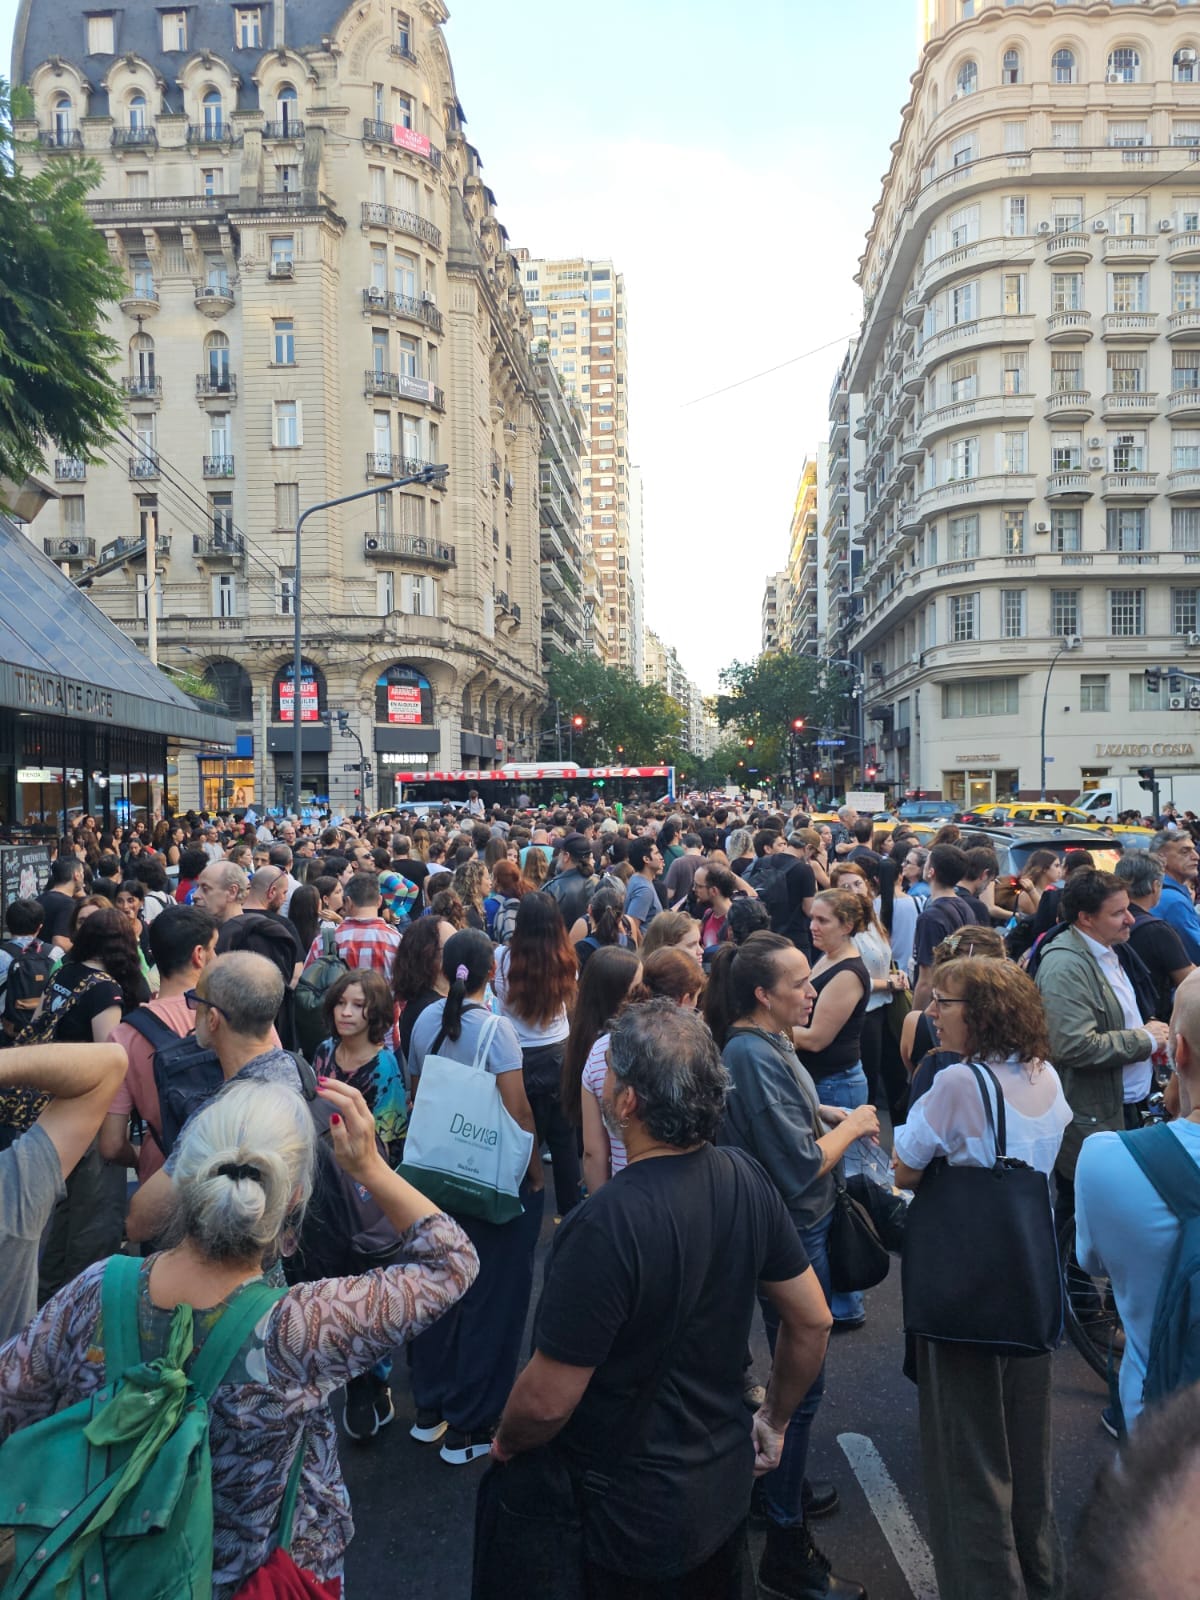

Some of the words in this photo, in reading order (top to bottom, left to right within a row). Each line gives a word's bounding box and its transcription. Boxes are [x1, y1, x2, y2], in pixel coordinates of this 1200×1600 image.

[15, 672, 65, 708] TIENDA
[67, 684, 83, 712] DE
[1151, 743, 1195, 758] COSTA
[382, 753, 429, 763] SAMSUNG
[413, 771, 491, 780] OLIVOS
[576, 767, 641, 778] BOCA
